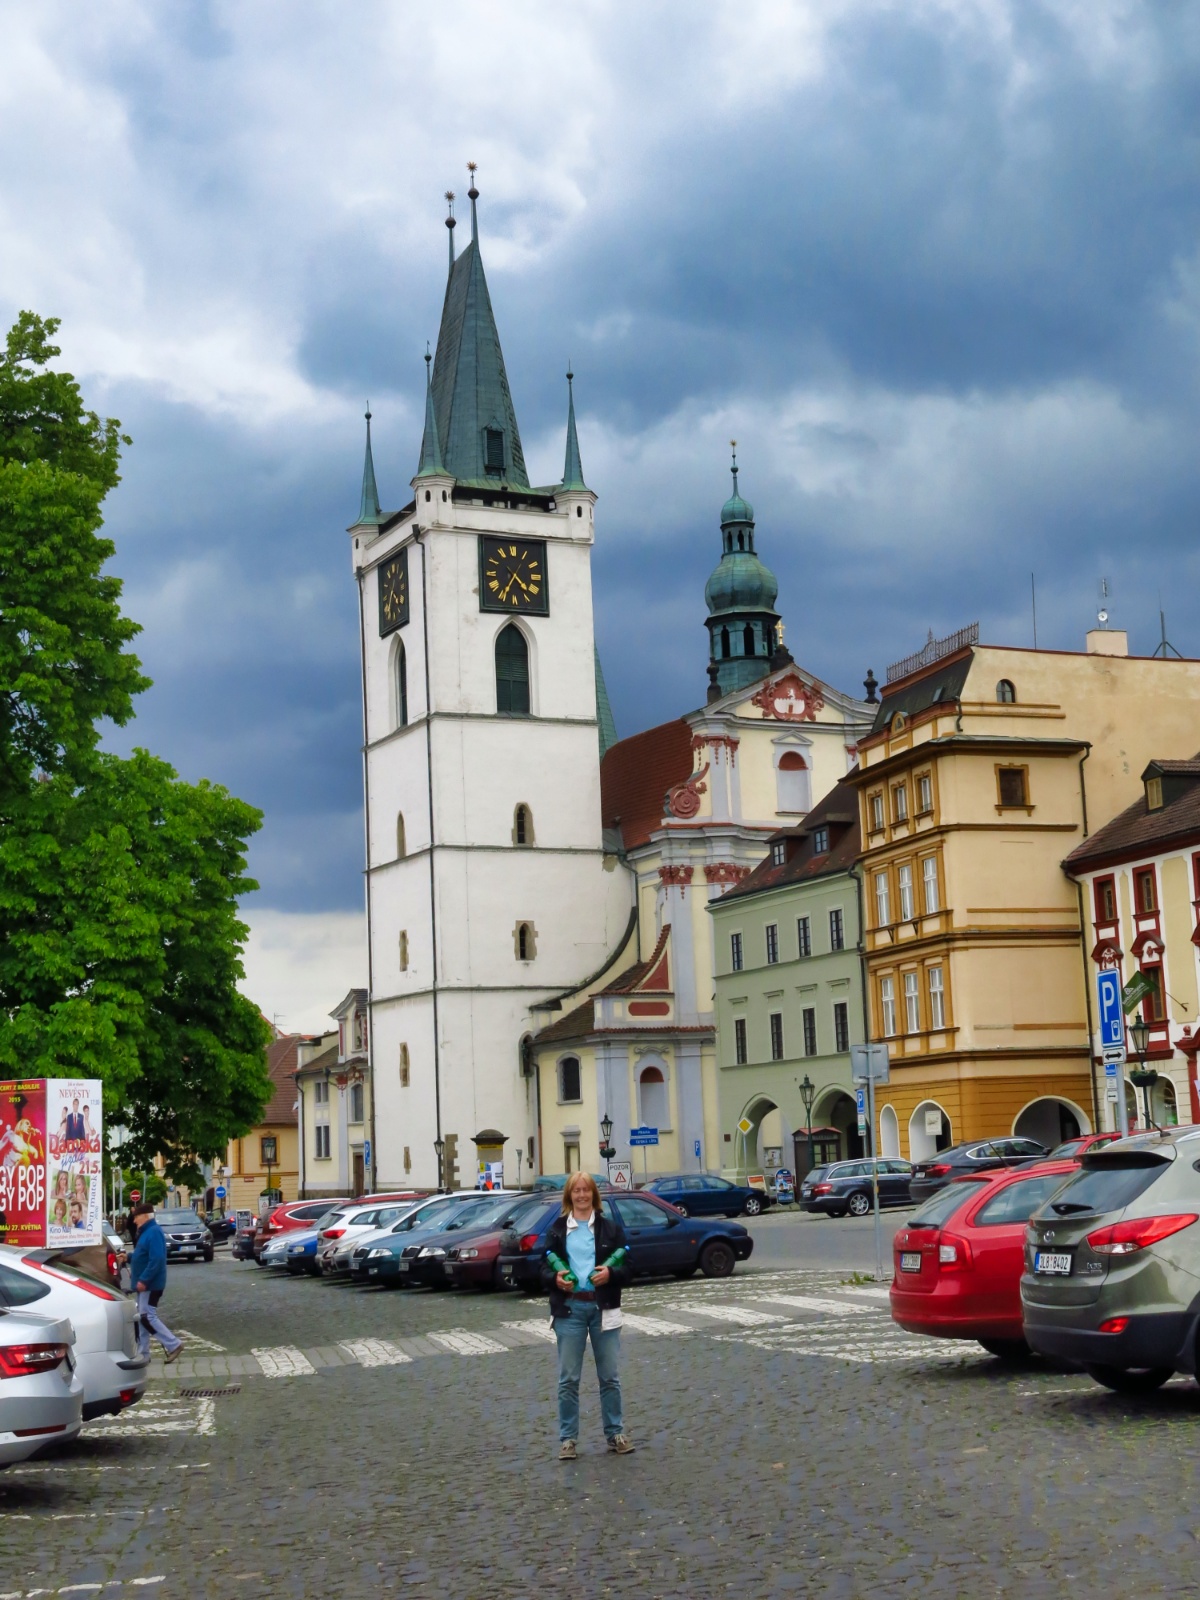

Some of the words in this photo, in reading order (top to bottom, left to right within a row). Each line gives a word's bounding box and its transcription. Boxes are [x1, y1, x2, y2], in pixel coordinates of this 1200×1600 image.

[1101, 981, 1115, 1023] P
[48, 1133, 101, 1160] Dámská
[18, 1164, 44, 1188] POP
[79, 1160, 101, 1175] 21.5.
[18, 1187, 44, 1211] POP
